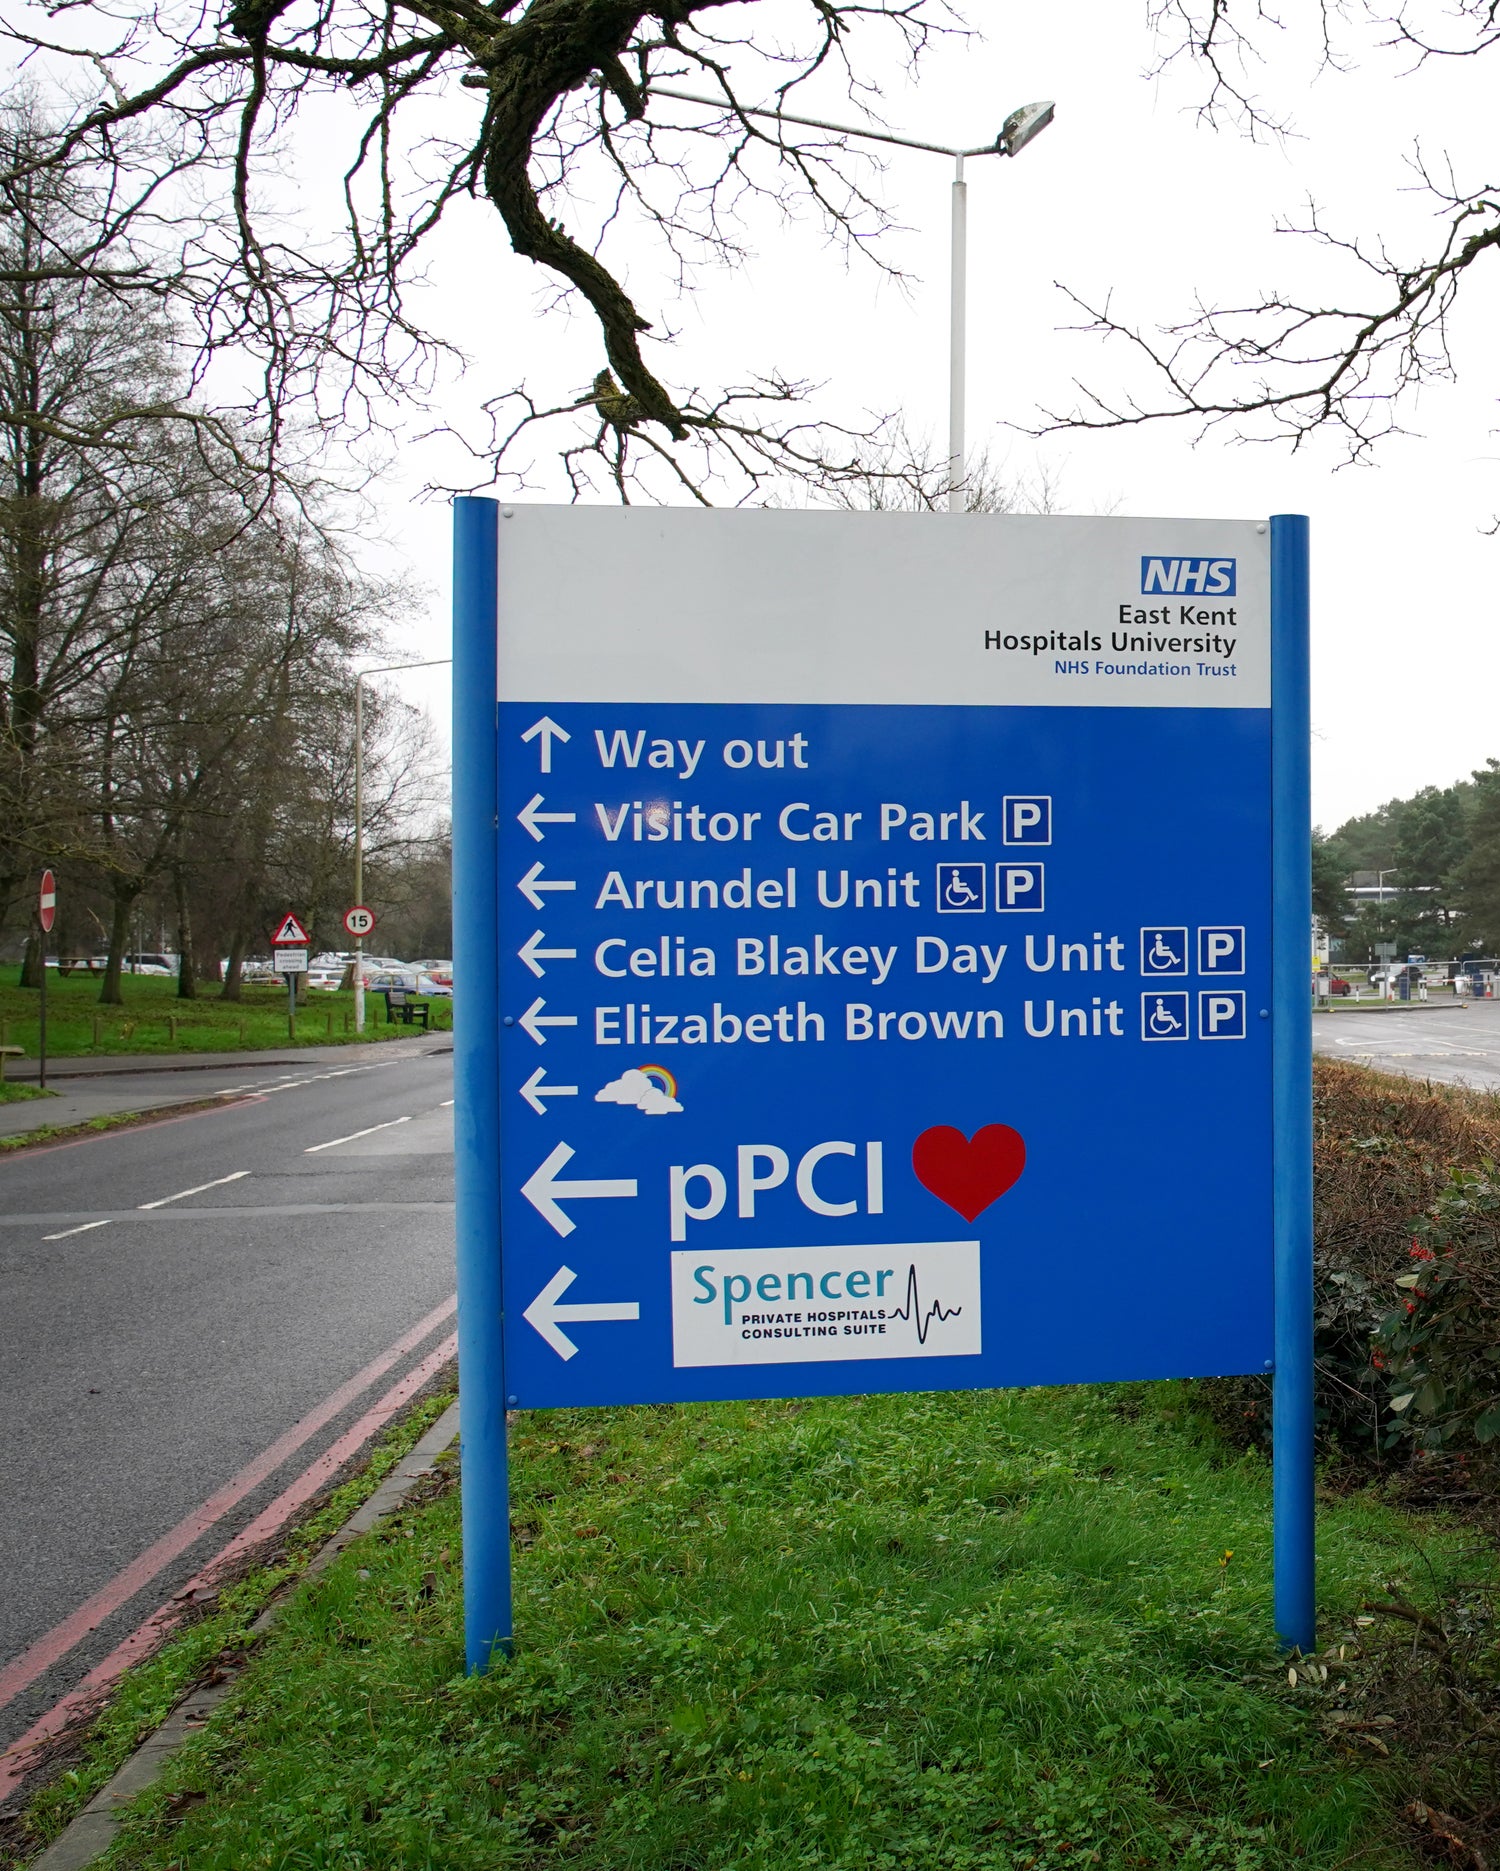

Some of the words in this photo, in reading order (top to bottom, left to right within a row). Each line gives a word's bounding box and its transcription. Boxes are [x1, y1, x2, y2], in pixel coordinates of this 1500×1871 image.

[1143, 559, 1233, 593] NHS
[1119, 604, 1171, 625] East
[1180, 605, 1237, 626] Kent
[984, 630, 1102, 656] Hospitals
[1111, 632, 1237, 659] University
[1055, 660, 1090, 675] NHS
[1095, 660, 1191, 676] Foundation
[1196, 662, 1237, 677] Trust
[594, 729, 706, 780] Way
[723, 732, 809, 769] out
[594, 801, 762, 842] Visitor
[778, 802, 862, 842] Car
[880, 800, 986, 841] Park
[1013, 803, 1041, 839] P
[594, 867, 796, 909] Arundel
[817, 867, 920, 909] Unit
[1006, 869, 1034, 905] P
[351, 915, 368, 928] 15
[594, 935, 716, 978] Celia
[737, 934, 898, 985] Blakey
[916, 936, 1008, 984] Day
[1025, 932, 1125, 973] Unit
[1208, 933, 1235, 968] P
[595, 1001, 825, 1045] Elizabeth
[846, 1003, 1004, 1041] Brown
[1024, 997, 1124, 1038] Unit
[1208, 997, 1236, 1033] P
[669, 1140, 884, 1242] pPCI
[692, 1265, 894, 1325] Spencer
[741, 1312, 802, 1325] PRIVATE
[807, 1309, 886, 1323] HOSPITALS
[741, 1325, 838, 1340] CONSULTING
[843, 1323, 887, 1336] SUITE
